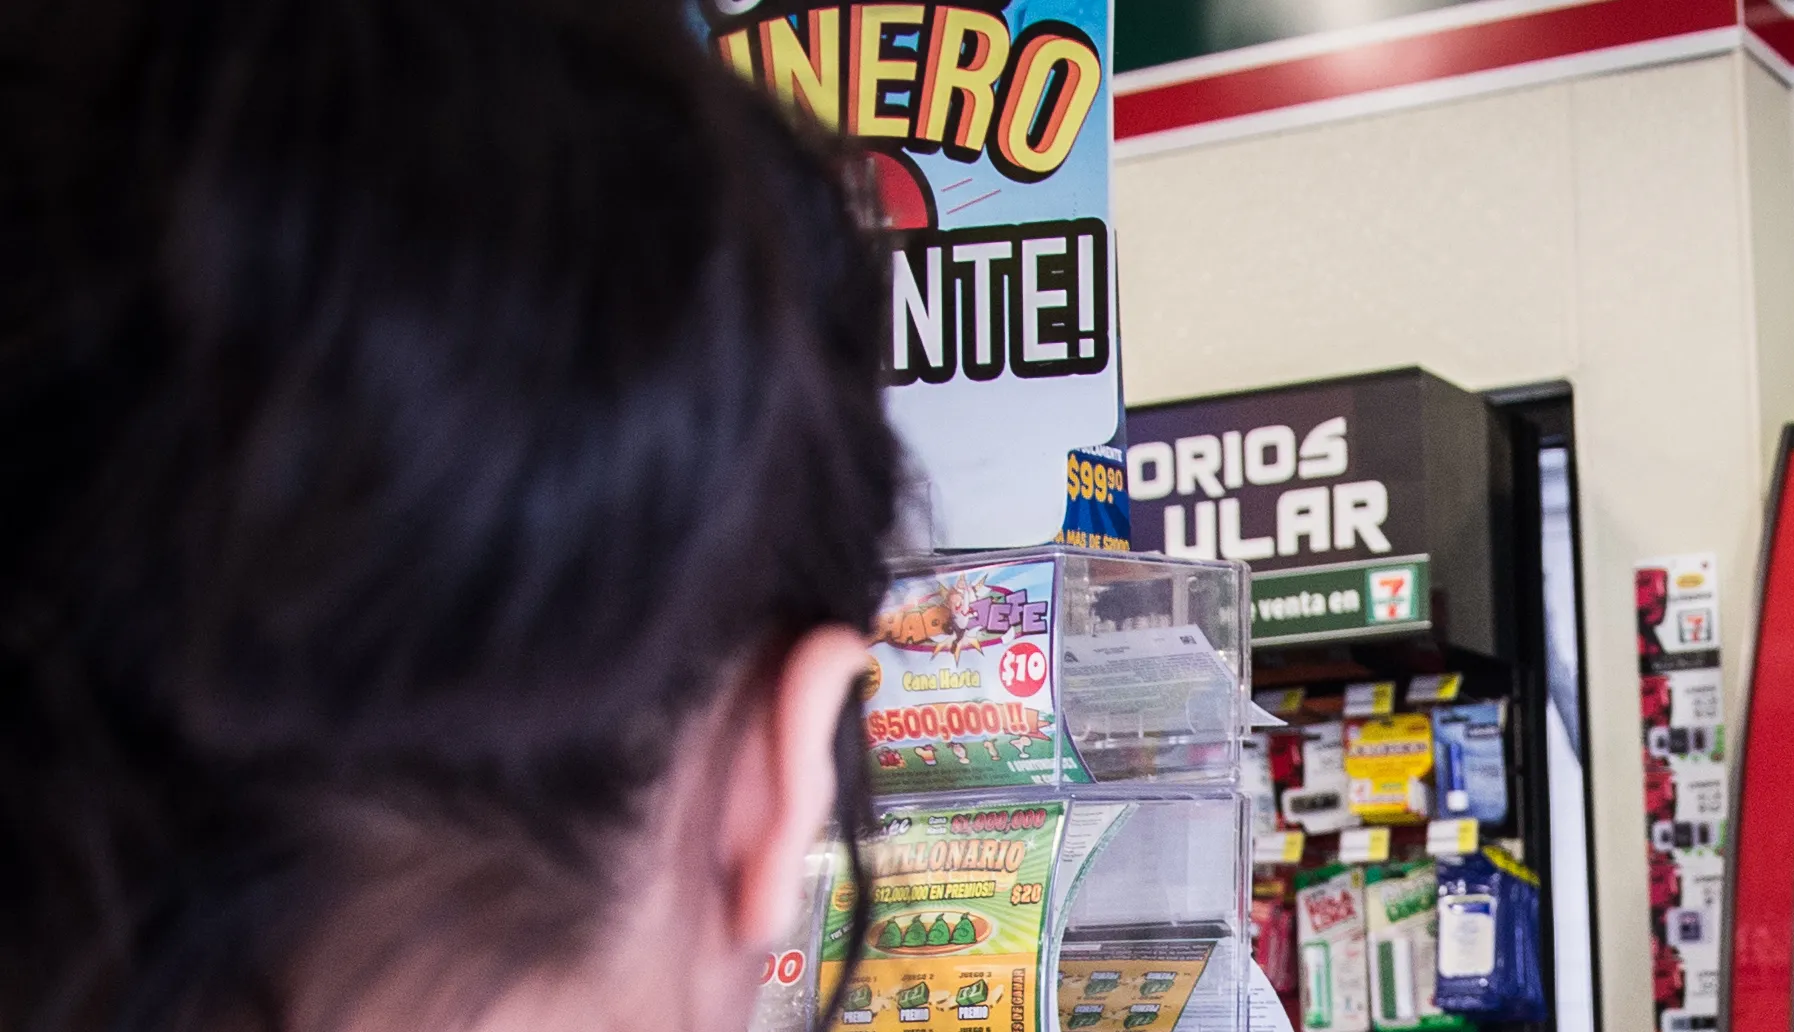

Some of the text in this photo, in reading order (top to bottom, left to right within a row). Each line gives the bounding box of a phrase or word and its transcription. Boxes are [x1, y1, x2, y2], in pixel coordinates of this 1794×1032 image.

[1126, 416, 1349, 500] ORIOS
[1164, 480, 1392, 561] ULAR
[1259, 590, 1327, 621] venta
[1329, 589, 1360, 613] en
[1002, 651, 1046, 687] $10
[868, 703, 1000, 742] $500,000
[1010, 883, 1042, 905] $20
